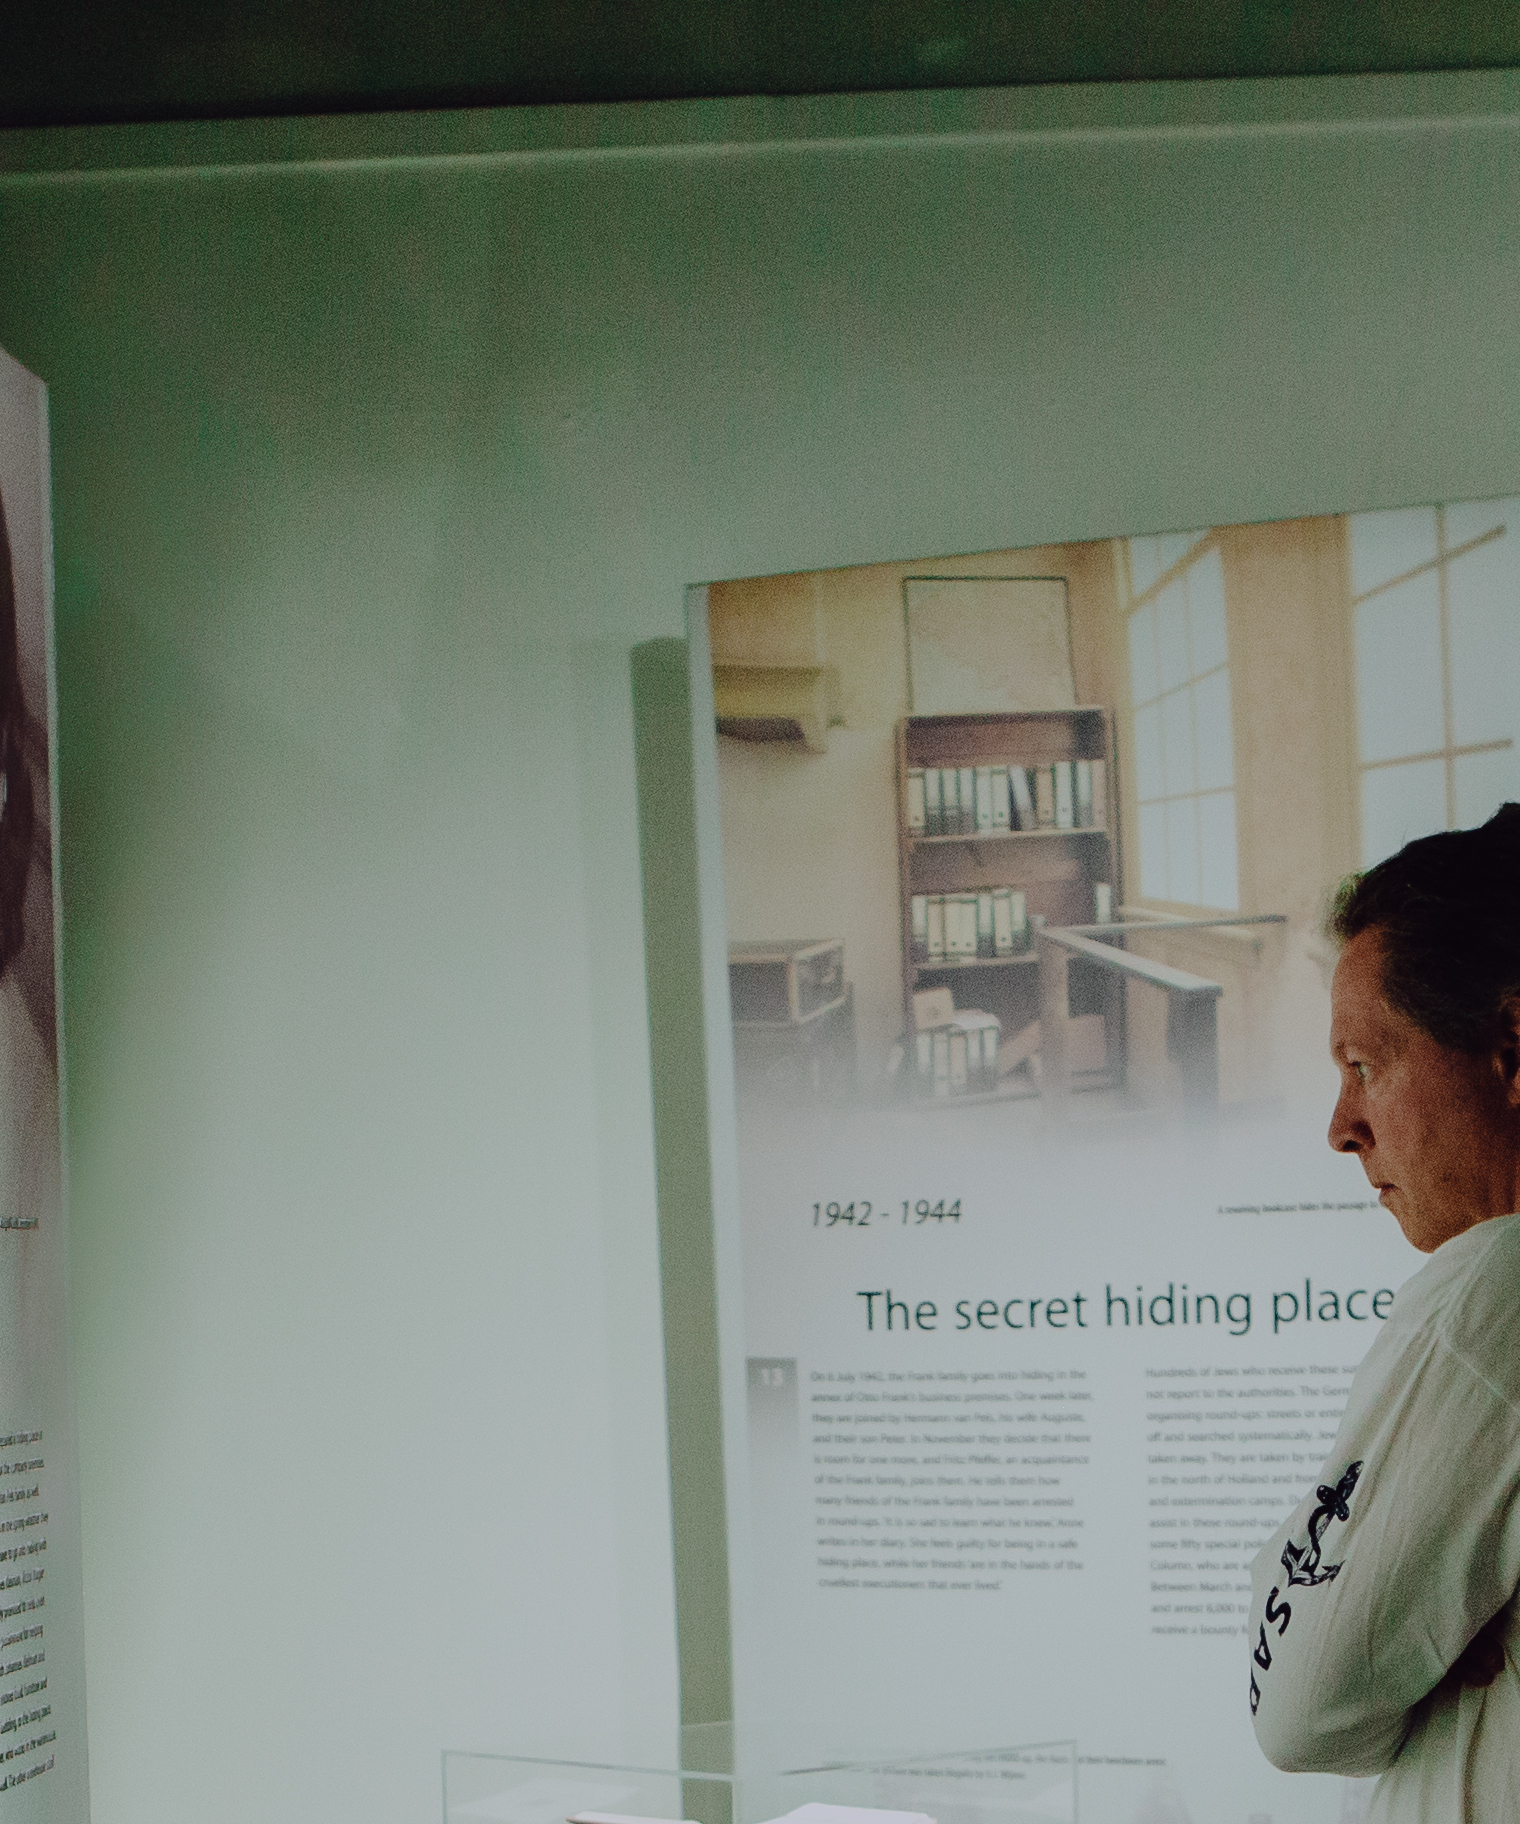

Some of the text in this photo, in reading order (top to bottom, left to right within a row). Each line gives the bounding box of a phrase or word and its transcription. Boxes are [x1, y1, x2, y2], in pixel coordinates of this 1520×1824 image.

[812, 1201, 872, 1227] 1942
[901, 1199, 962, 1225] 1944
[855, 1277, 1396, 1336] The secret hiding place
